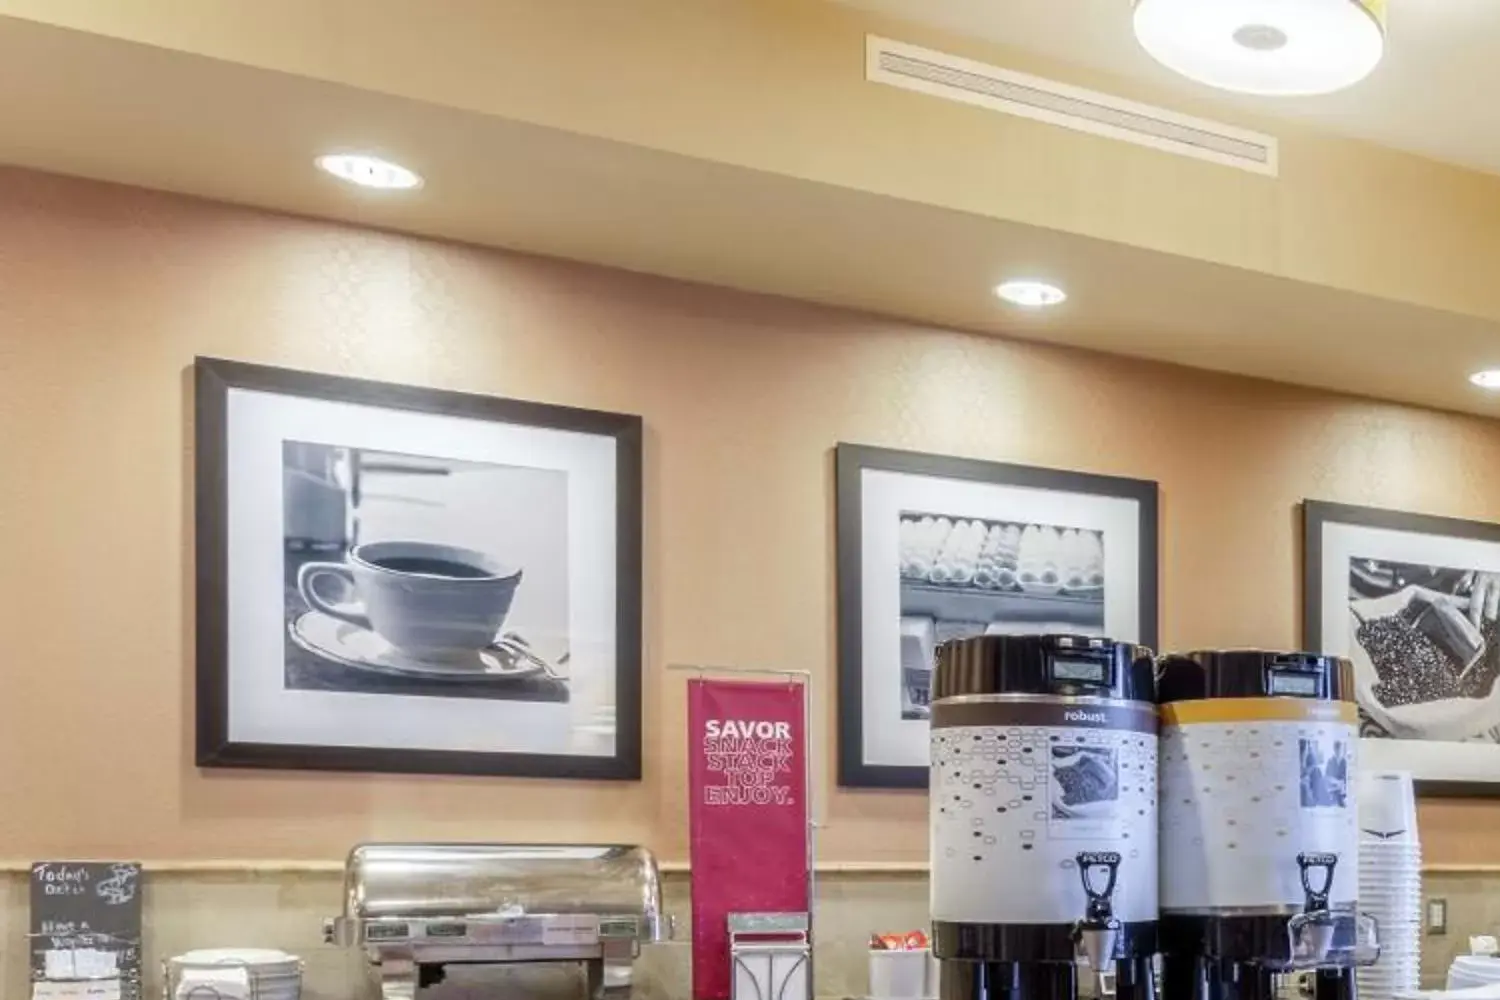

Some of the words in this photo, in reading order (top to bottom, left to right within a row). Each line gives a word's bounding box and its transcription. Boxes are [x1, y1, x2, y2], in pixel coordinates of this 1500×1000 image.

[1064, 710, 1106, 722] robust
[705, 719, 790, 739] SAVOR
[703, 737, 793, 756] SNACK
[706, 752, 792, 773] STACK
[723, 768, 775, 789] TOP
[703, 785, 795, 805] ENJOY.
